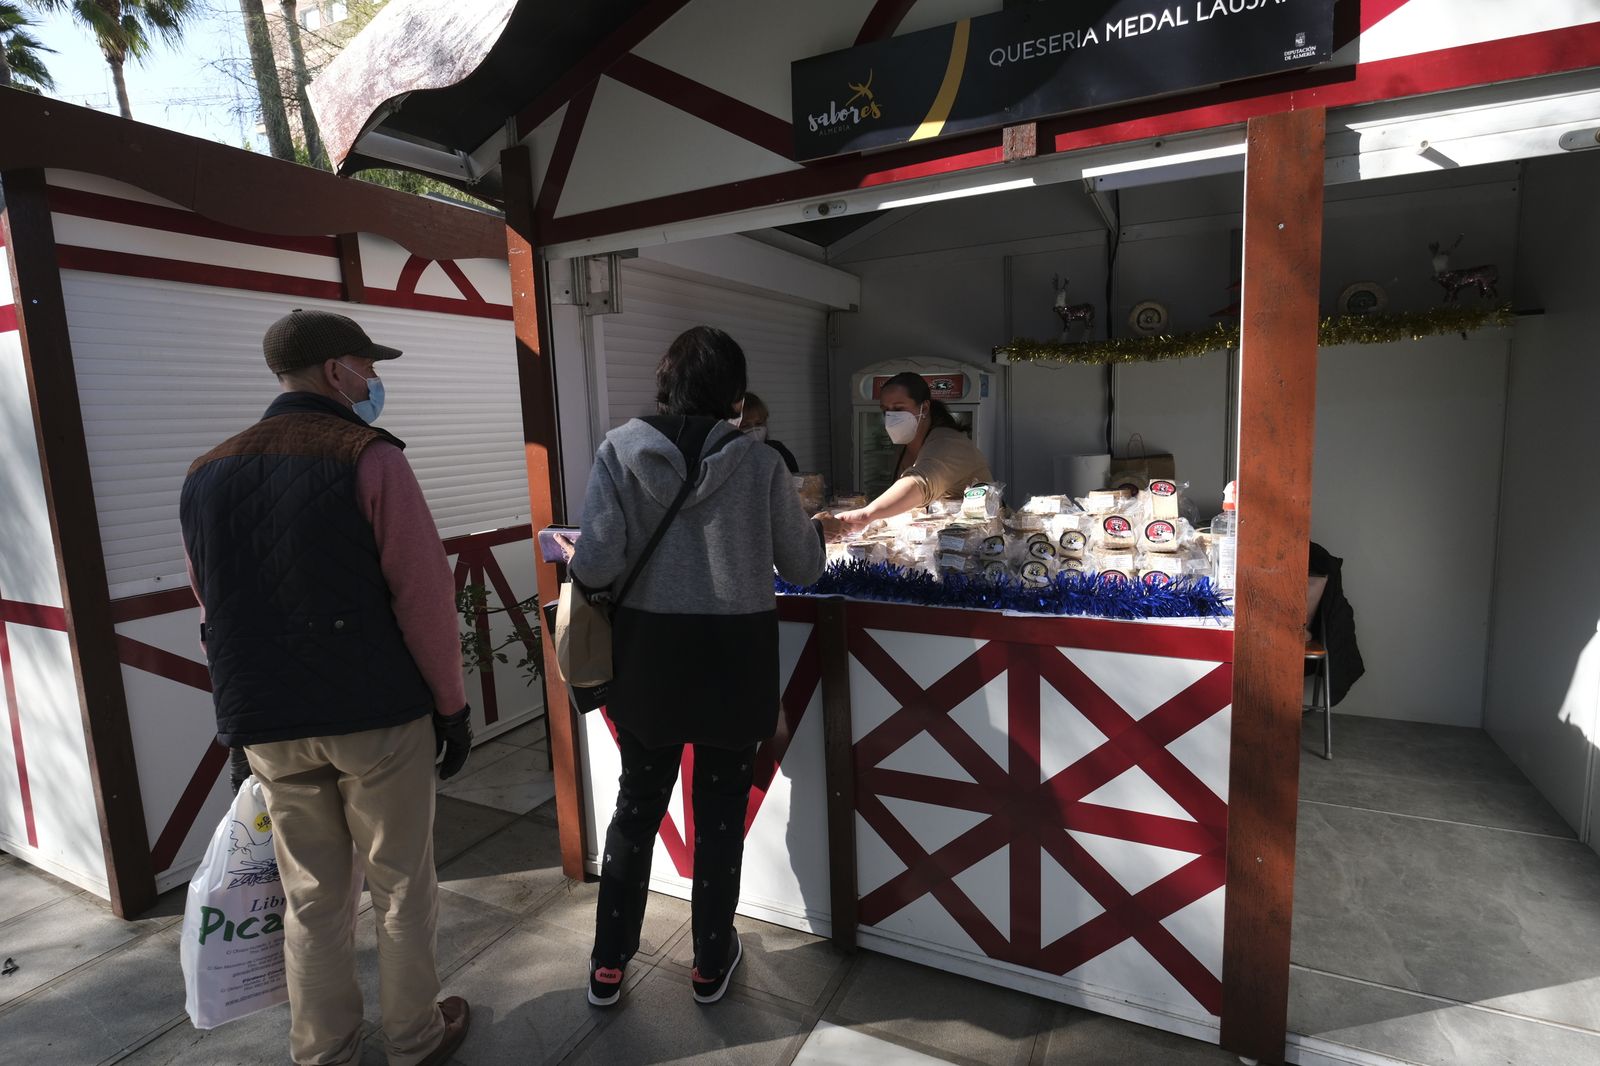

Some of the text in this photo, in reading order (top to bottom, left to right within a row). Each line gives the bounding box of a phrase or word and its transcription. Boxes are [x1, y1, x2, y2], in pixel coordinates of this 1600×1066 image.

[989, 27, 1099, 67] QUESERIA
[1106, 6, 1189, 42] MEDAL
[808, 100, 883, 132] sabores
